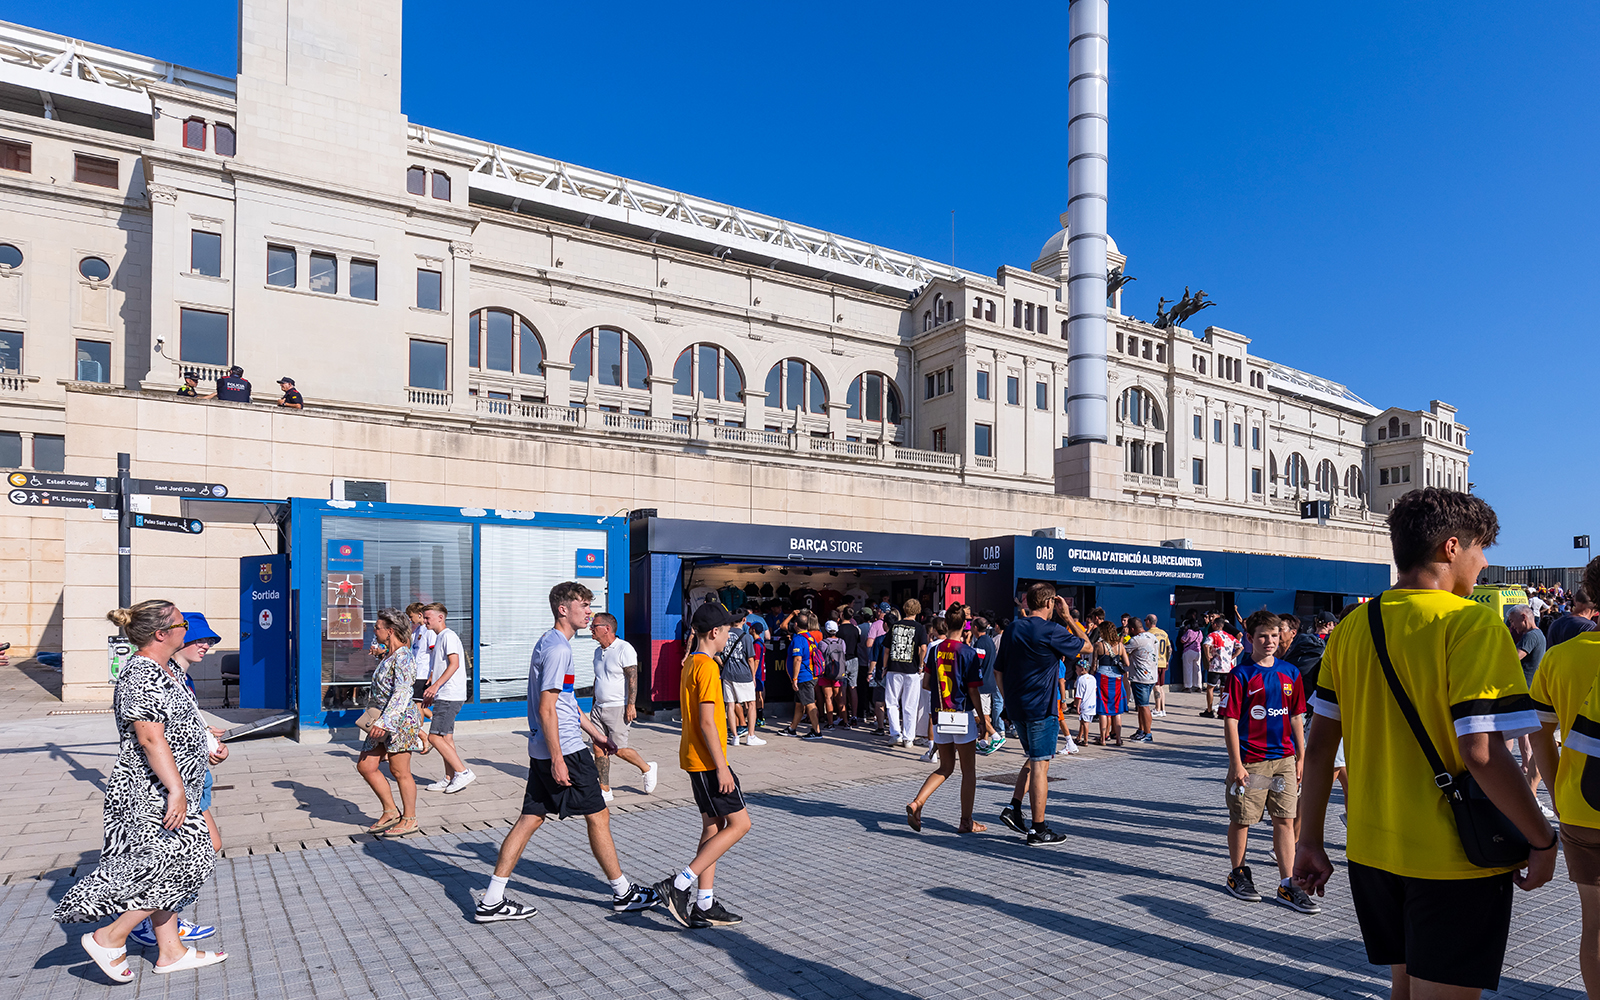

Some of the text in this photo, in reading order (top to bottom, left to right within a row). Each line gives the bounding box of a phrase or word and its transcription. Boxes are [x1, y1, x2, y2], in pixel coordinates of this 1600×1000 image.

[1305, 503, 1310, 516] 1
[1323, 503, 1327, 516] 1
[790, 538, 863, 554] BARÇA STORE
[983, 545, 1000, 560] OAB
[1036, 545, 1054, 560] OAB
[1068, 548, 1202, 567] OFICINA D'ATENCIÓ AL BARCELONISTA
[1036, 562, 1057, 571] GOL OEST
[252, 590, 280, 600] Sortida
[806, 598, 812, 609] 9
[936, 651, 955, 660] PUYOL
[938, 664, 953, 698] 5
